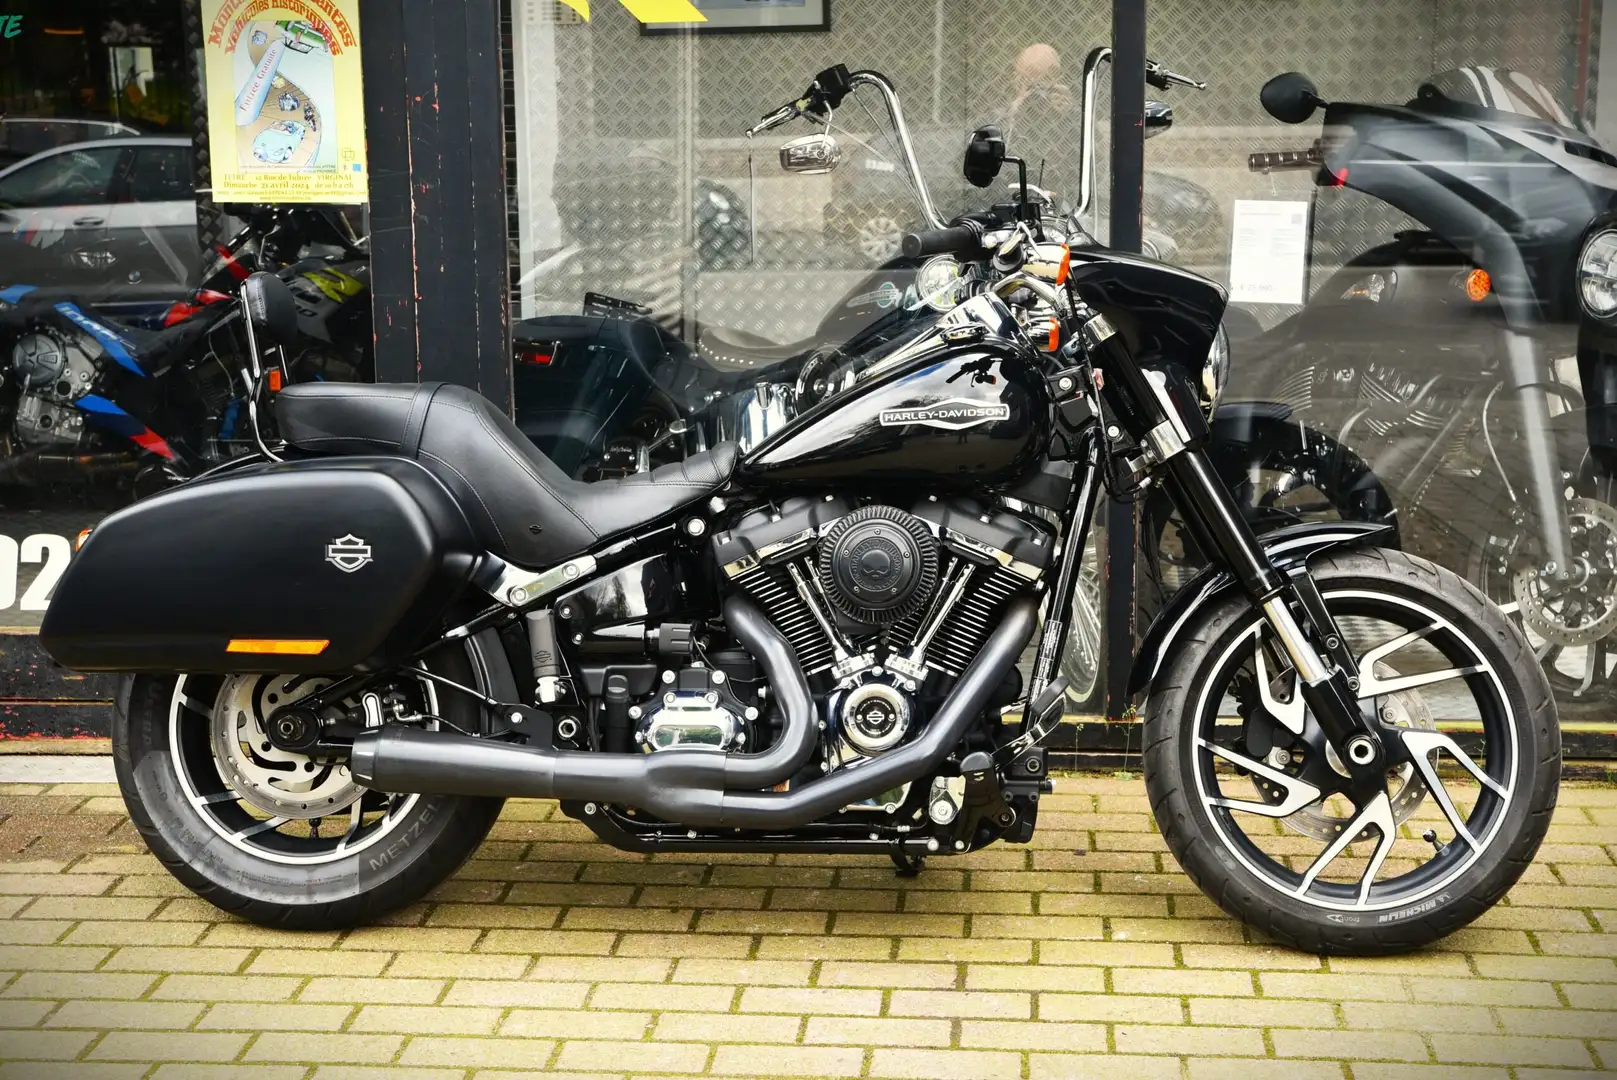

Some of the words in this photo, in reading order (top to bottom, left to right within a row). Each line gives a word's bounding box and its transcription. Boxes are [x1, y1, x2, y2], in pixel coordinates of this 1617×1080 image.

[884, 407, 1006, 422] HARLEY-DAVIDSON
[368, 800, 442, 871] METZEL
[1378, 901, 1437, 923] MICHELIN
